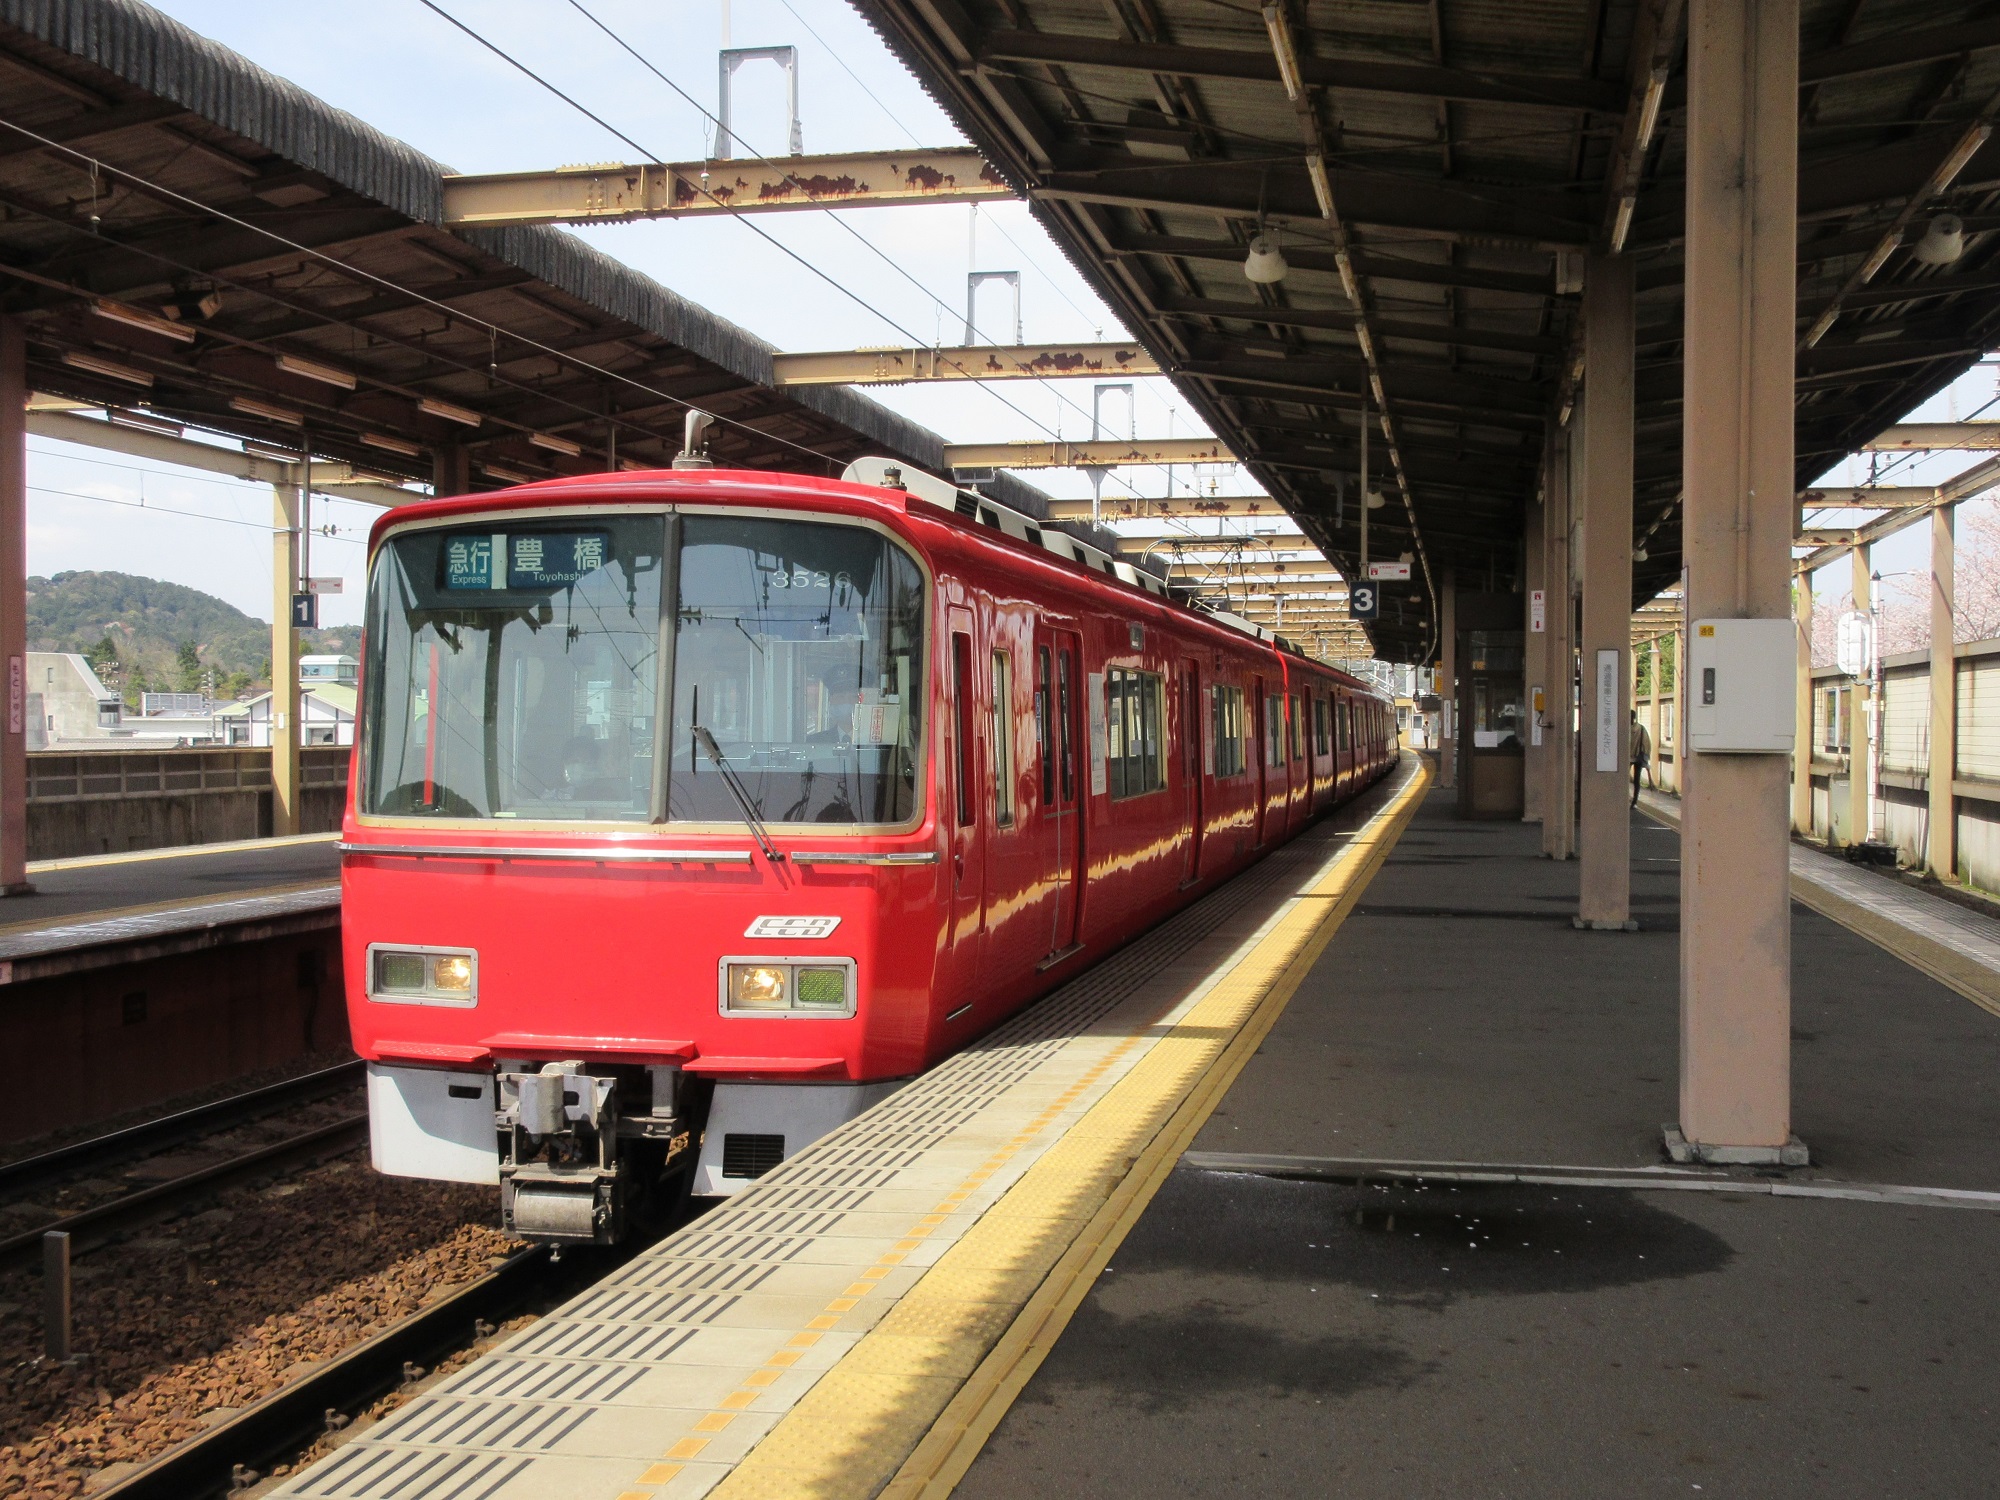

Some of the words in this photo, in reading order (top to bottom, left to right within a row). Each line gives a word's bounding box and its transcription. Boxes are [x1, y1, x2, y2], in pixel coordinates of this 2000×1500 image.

[449, 541, 490, 574] 急行
[515, 537, 602, 571] 豊橋
[452, 574, 487, 585] Express
[533, 571, 584, 583] Toyohashi
[772, 570, 851, 588] 3526
[296, 600, 308, 621] 1
[1354, 588, 1374, 612] 3
